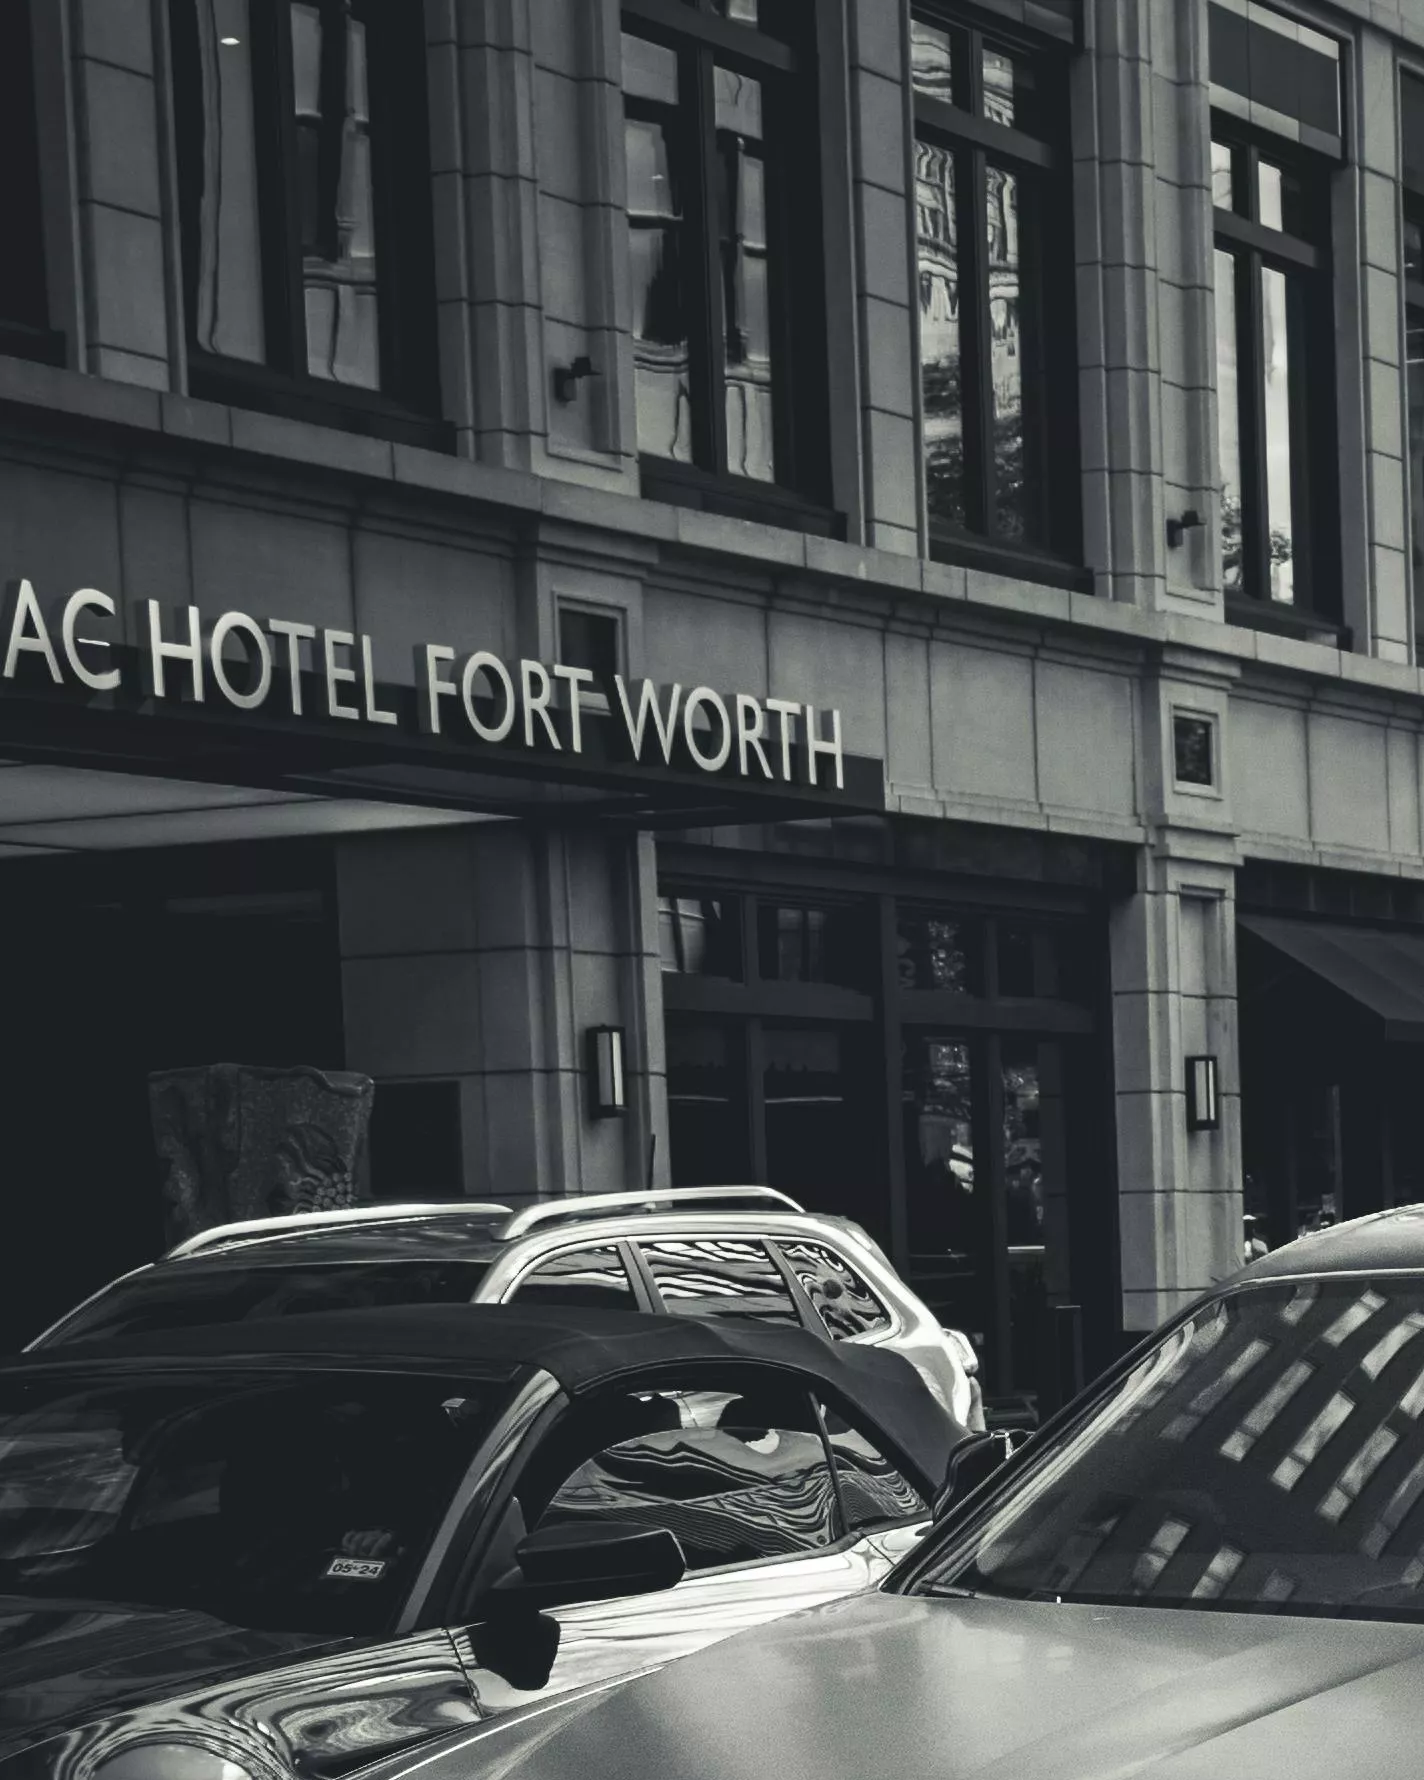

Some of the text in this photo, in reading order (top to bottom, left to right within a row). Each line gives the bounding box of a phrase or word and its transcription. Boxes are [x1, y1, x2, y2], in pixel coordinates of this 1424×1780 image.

[3, 577, 845, 790] AC HOTEL FORT WORTH
